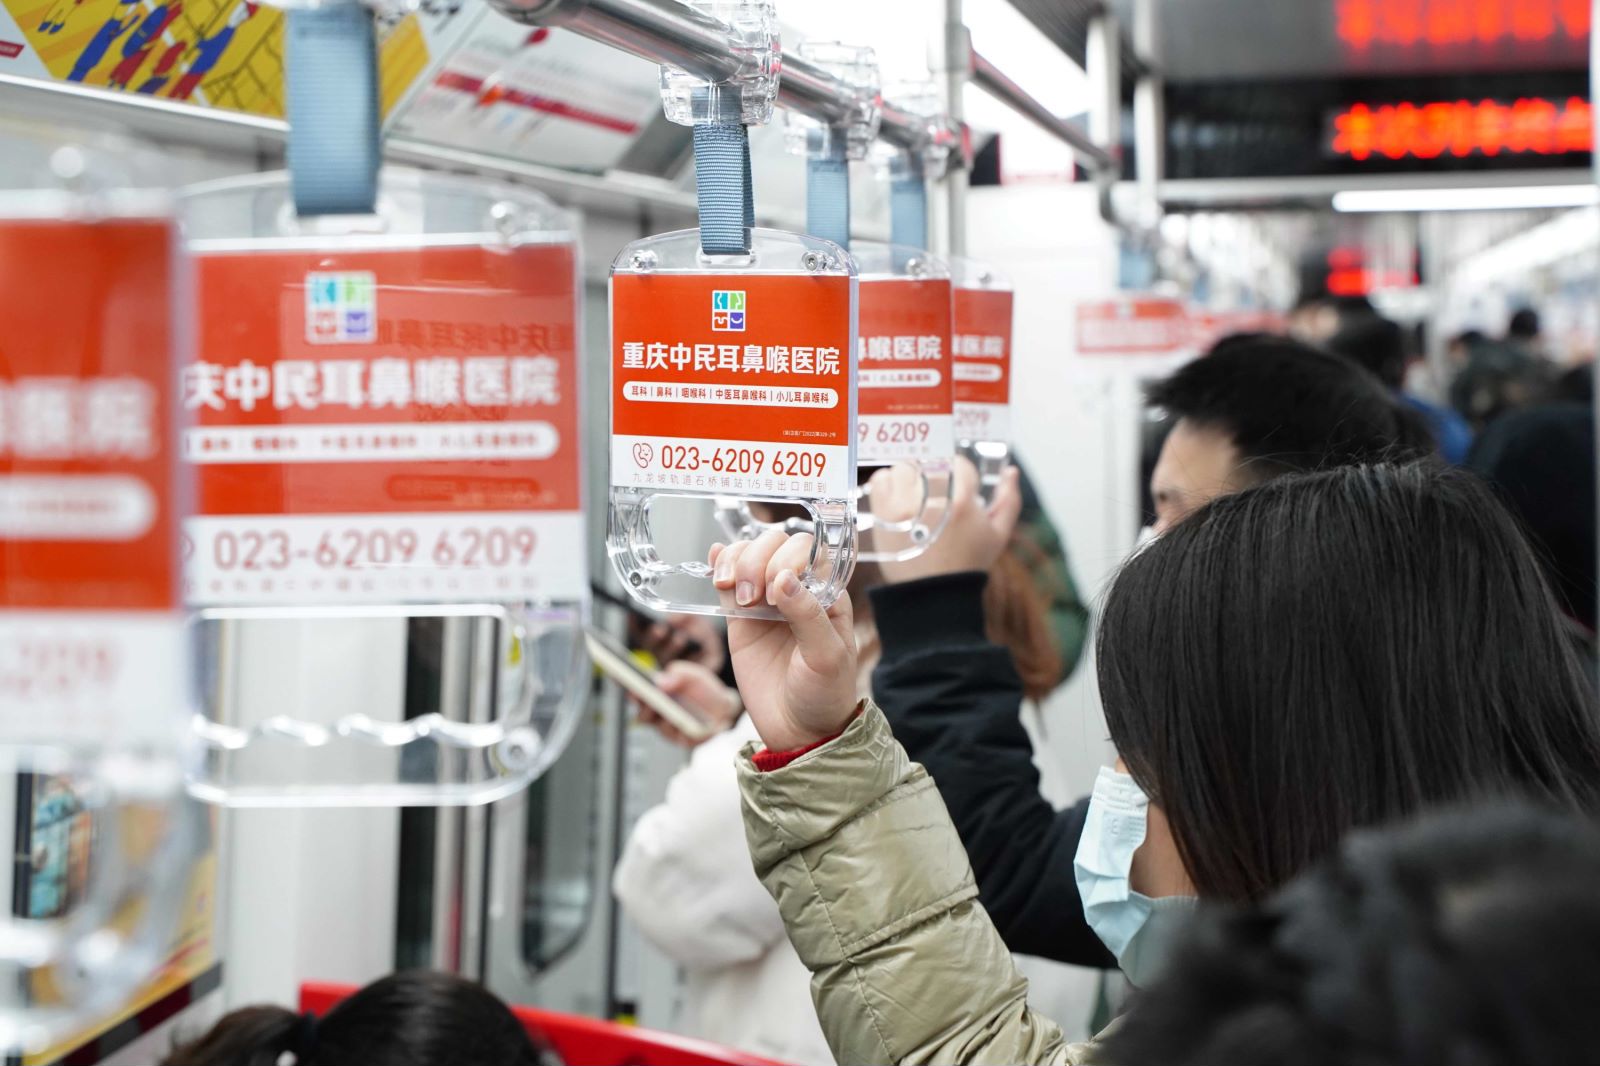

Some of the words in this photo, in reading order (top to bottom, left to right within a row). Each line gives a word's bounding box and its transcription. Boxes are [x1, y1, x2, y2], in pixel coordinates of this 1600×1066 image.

[622, 341, 840, 375] 重庆中民耳鼻喉医院
[631, 385, 648, 396] 耳科
[656, 386, 673, 397] 鼻科
[715, 388, 767, 401] 中医耳鼻喉科
[776, 391, 829, 404] 小儿耳鼻喉科
[876, 422, 931, 443] 6209
[661, 445, 765, 474] 023-6209
[771, 450, 827, 478] 6209
[213, 528, 419, 571] 023-6209
[431, 526, 538, 568] 6209
